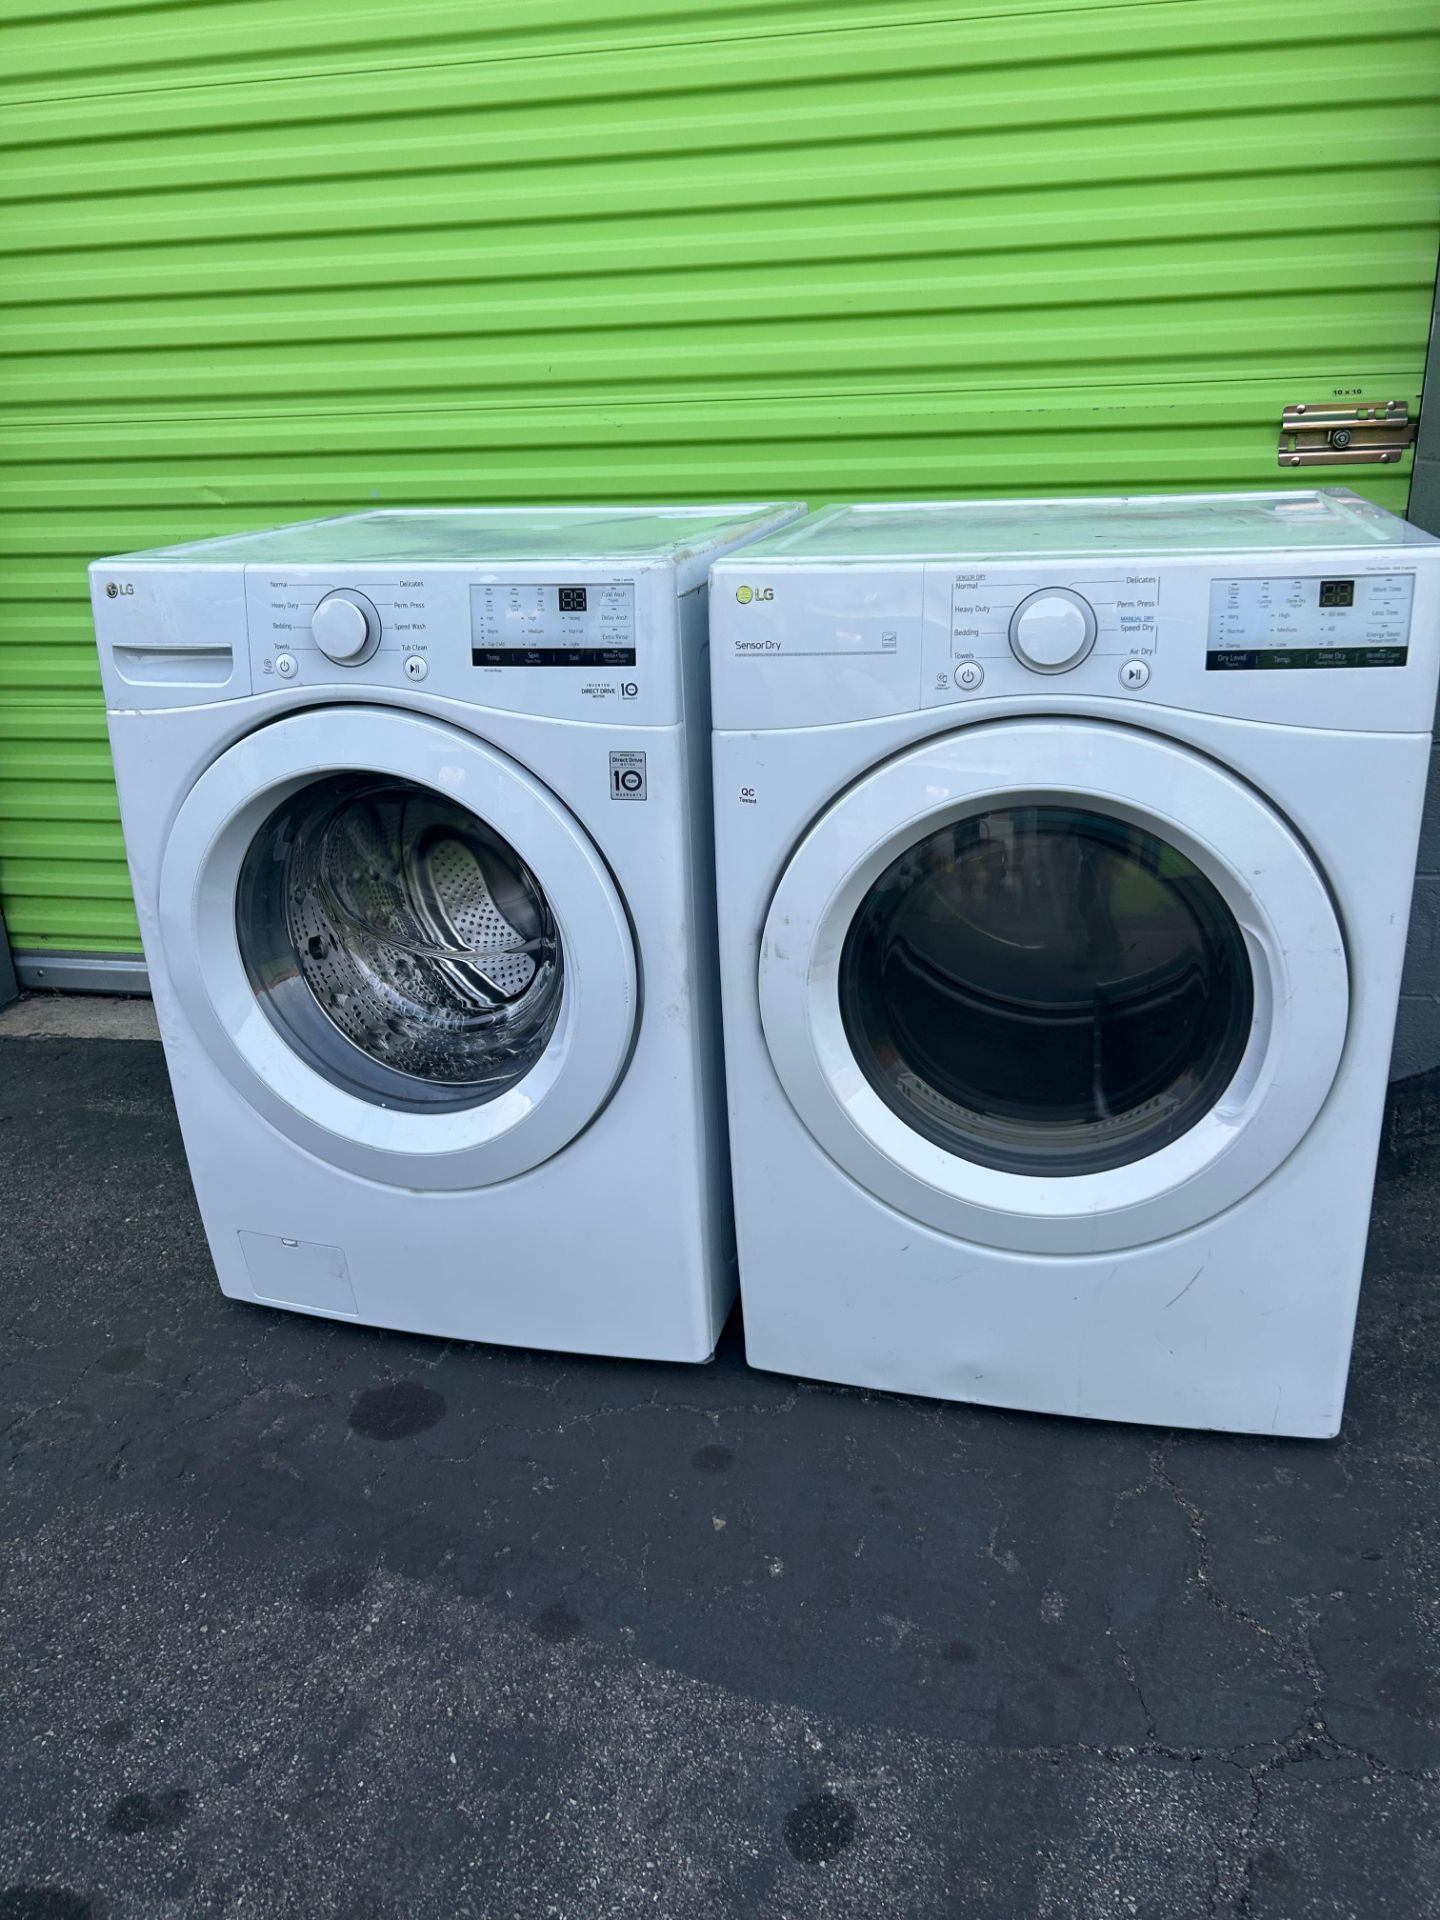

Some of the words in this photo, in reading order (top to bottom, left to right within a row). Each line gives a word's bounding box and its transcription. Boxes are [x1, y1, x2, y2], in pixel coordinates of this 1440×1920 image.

[399, 580, 424, 588] Delicates
[119, 583, 135, 596] LG
[755, 588, 774, 601] LG
[287, 602, 299, 610] Duty
[954, 605, 974, 614] Heavy
[975, 605, 991, 613] Duty
[273, 623, 292, 631] Bedding
[394, 623, 410, 631] Speed
[1121, 624, 1140, 632] Speed
[1142, 624, 1155, 632] Dry
[954, 629, 979, 637] Bedding
[1141, 648, 1153, 656] Dry
[1230, 653, 1247, 661] Level
[621, 682, 639, 697] 10
[613, 769, 643, 792] 10
[741, 787, 755, 797] QC
[739, 796, 757, 805] Tested
